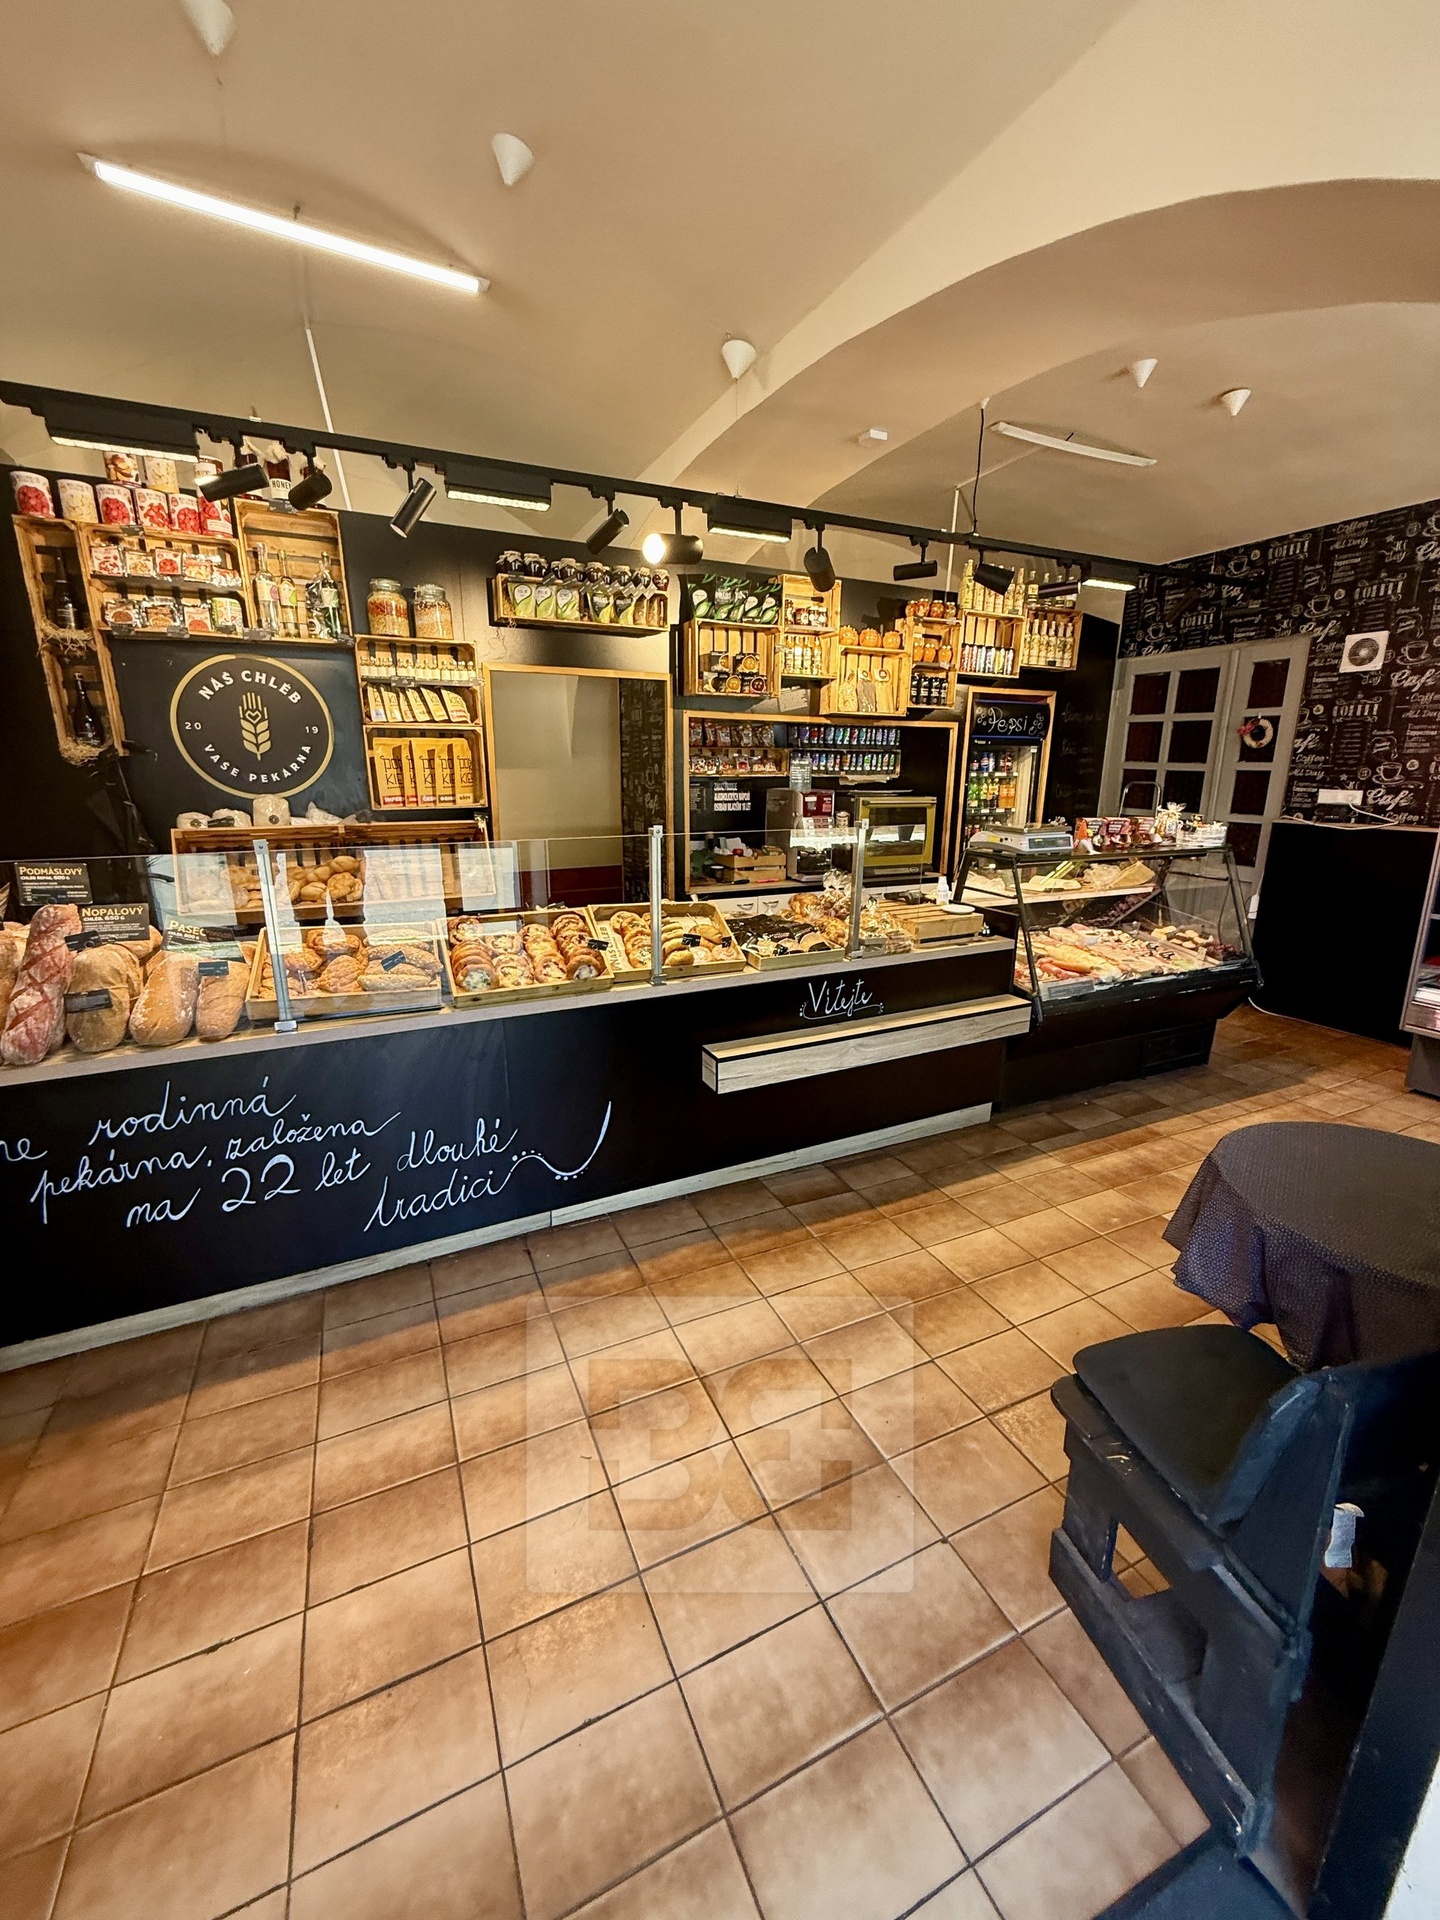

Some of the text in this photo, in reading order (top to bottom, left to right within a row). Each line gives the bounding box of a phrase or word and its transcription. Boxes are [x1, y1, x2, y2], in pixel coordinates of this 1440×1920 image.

[198, 670, 302, 704] NÁŠ CHLÉB
[185, 722, 319, 734] 20 19
[987, 706, 1028, 735] Pepsi
[204, 744, 312, 783] VAŠE PEKÁRNA
[82, 905, 144, 917] NOPALOVÝ
[88, 1076, 297, 1146] rodinná
[226, 1112, 401, 1160] založena
[220, 1154, 301, 1212] 22
[315, 1148, 371, 1191] let
[396, 1118, 519, 1172] dlouhé
[364, 1170, 512, 1232] tradici
